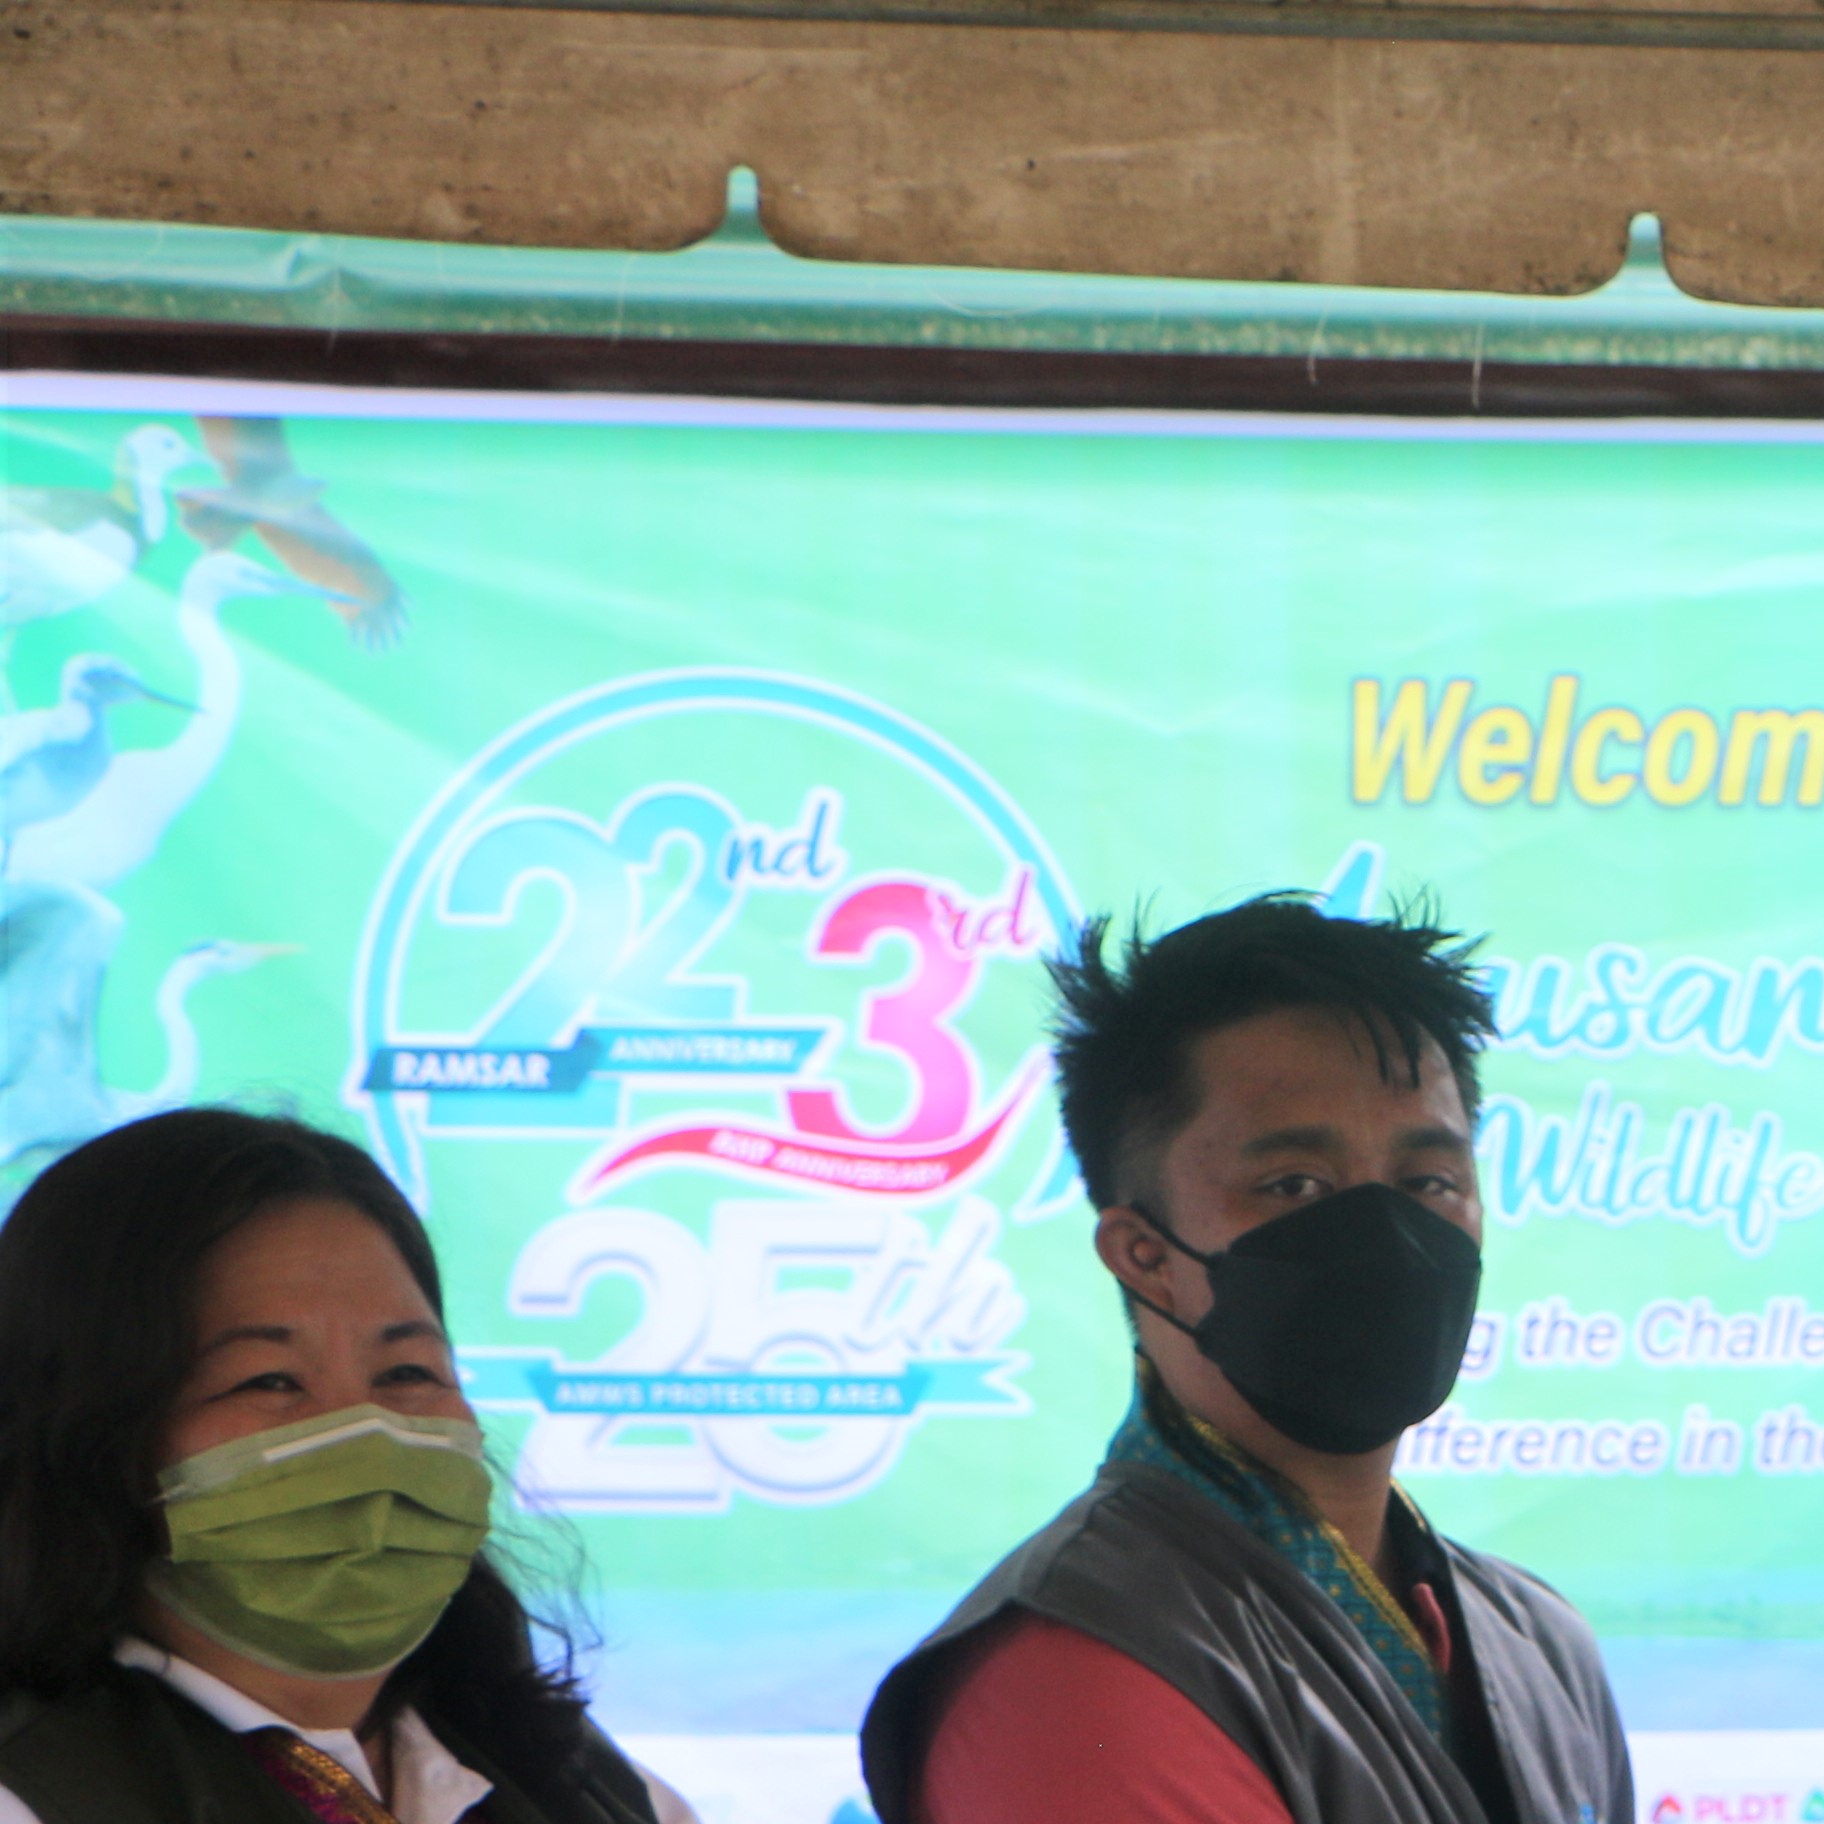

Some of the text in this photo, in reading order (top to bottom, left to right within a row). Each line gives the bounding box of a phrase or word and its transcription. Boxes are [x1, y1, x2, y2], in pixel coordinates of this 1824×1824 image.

[786, 865, 1038, 1146] 3rd
[609, 1035, 797, 1065] ANNIVERSARY
[391, 1051, 552, 1091] RAMSAR
[772, 1149, 951, 1190] ANNIVERSARY
[1520, 1301, 1619, 1360] the
[512, 1199, 1024, 1512] 25th
[557, 1379, 904, 1412] AMWS PROTECTED AREA
[1394, 1408, 1660, 1468] fference
[1682, 1406, 1737, 1466] in
[1693, 1795, 1788, 1824] PLDT
